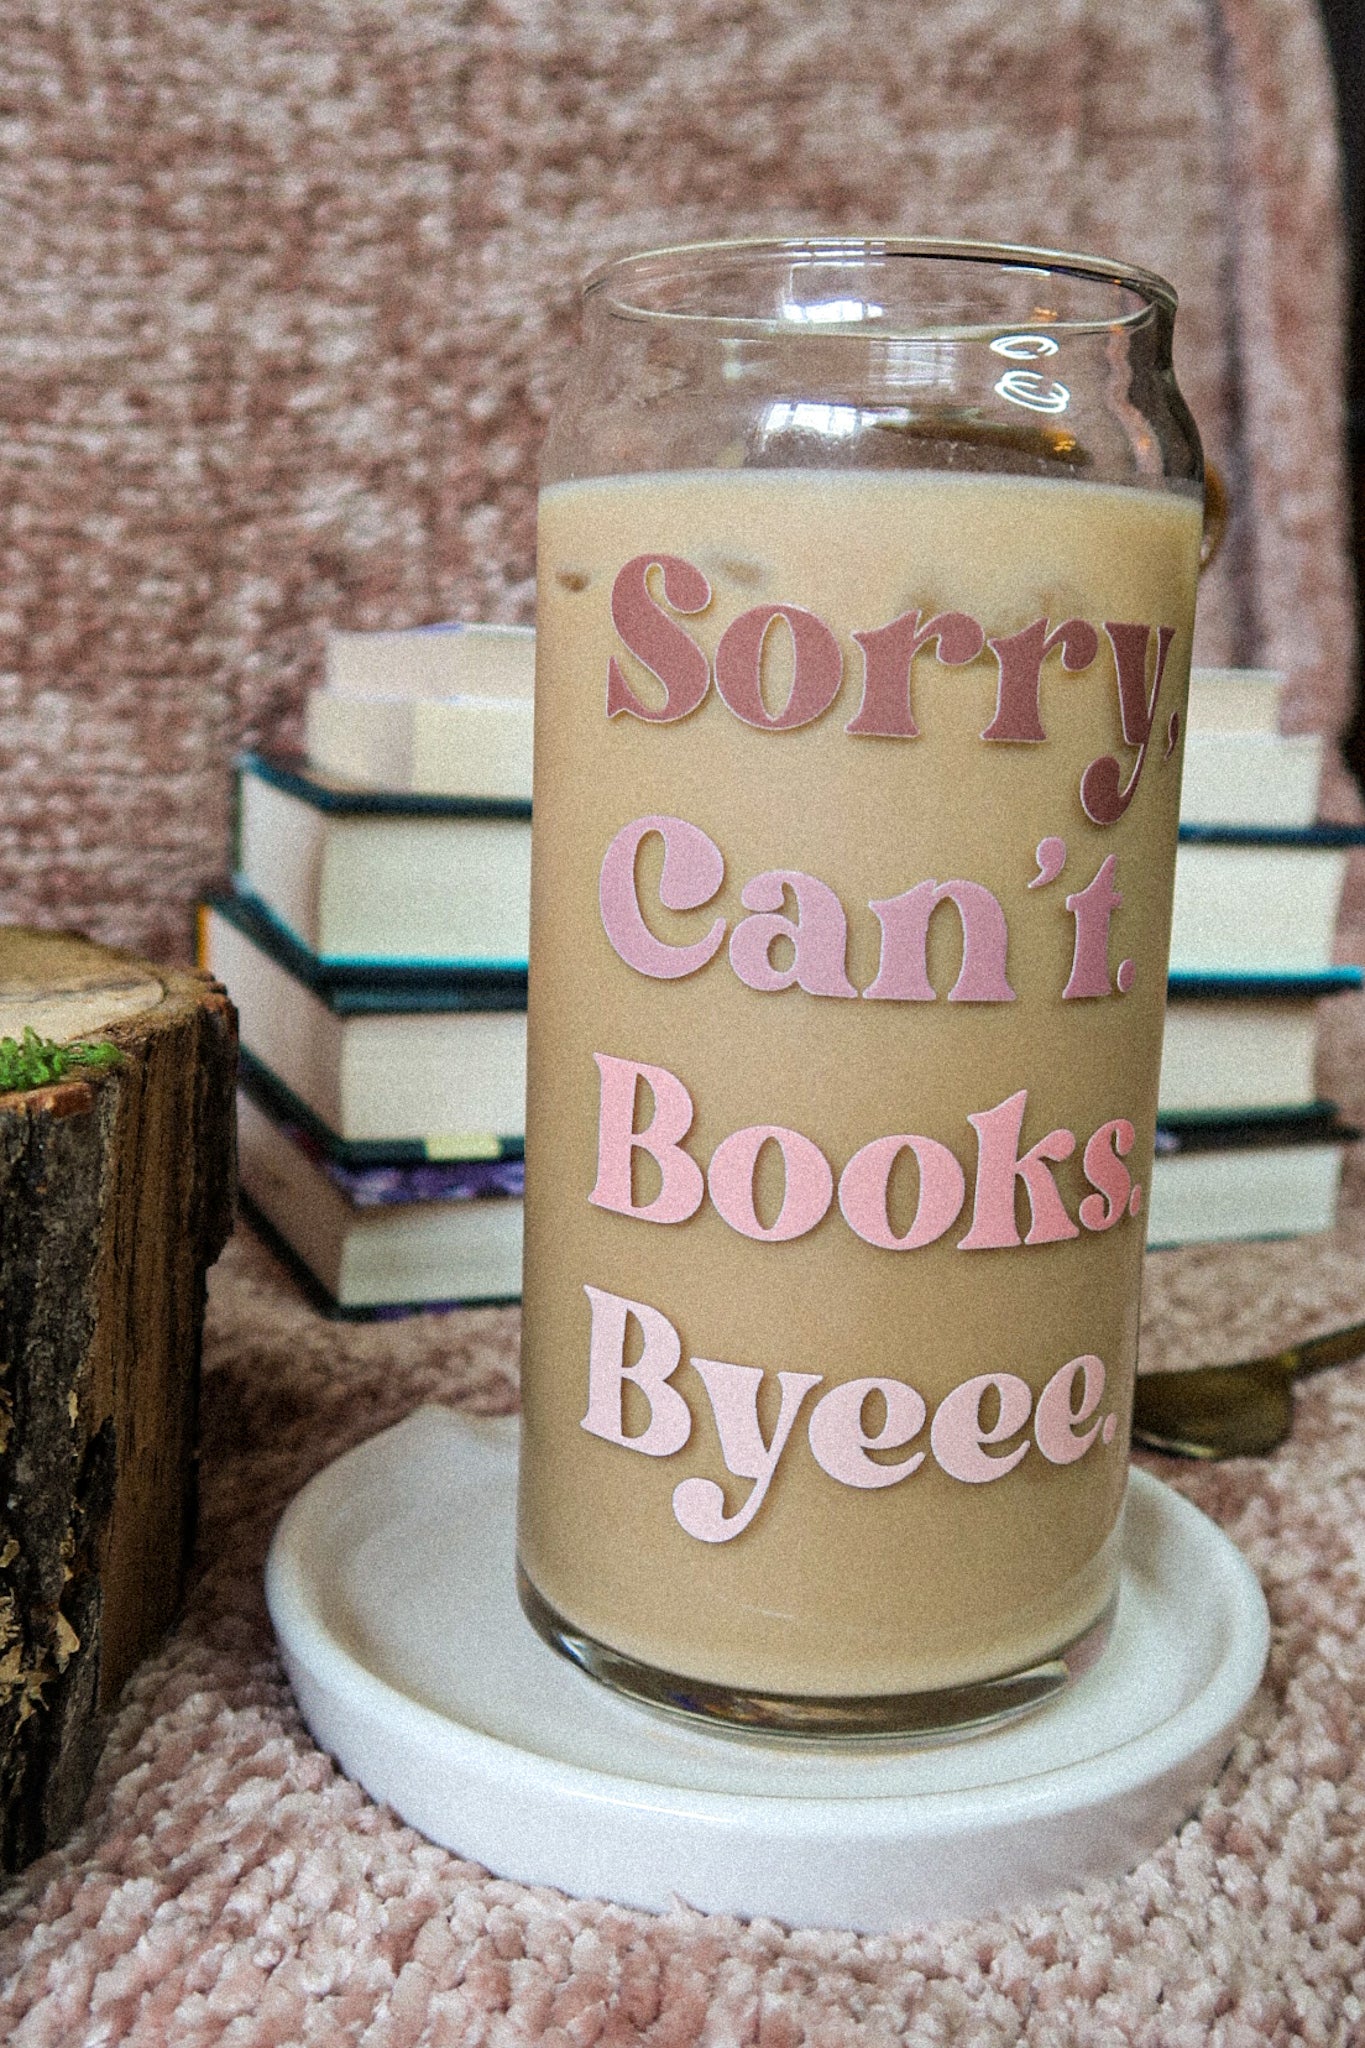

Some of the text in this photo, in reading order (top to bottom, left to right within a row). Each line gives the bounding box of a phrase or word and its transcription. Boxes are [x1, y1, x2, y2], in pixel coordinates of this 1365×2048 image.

[606, 552, 1179, 825] Sorry,
[599, 815, 1136, 1002] Can't.
[587, 1052, 1142, 1250] Books.
[579, 1285, 1118, 1543] Byeee.
